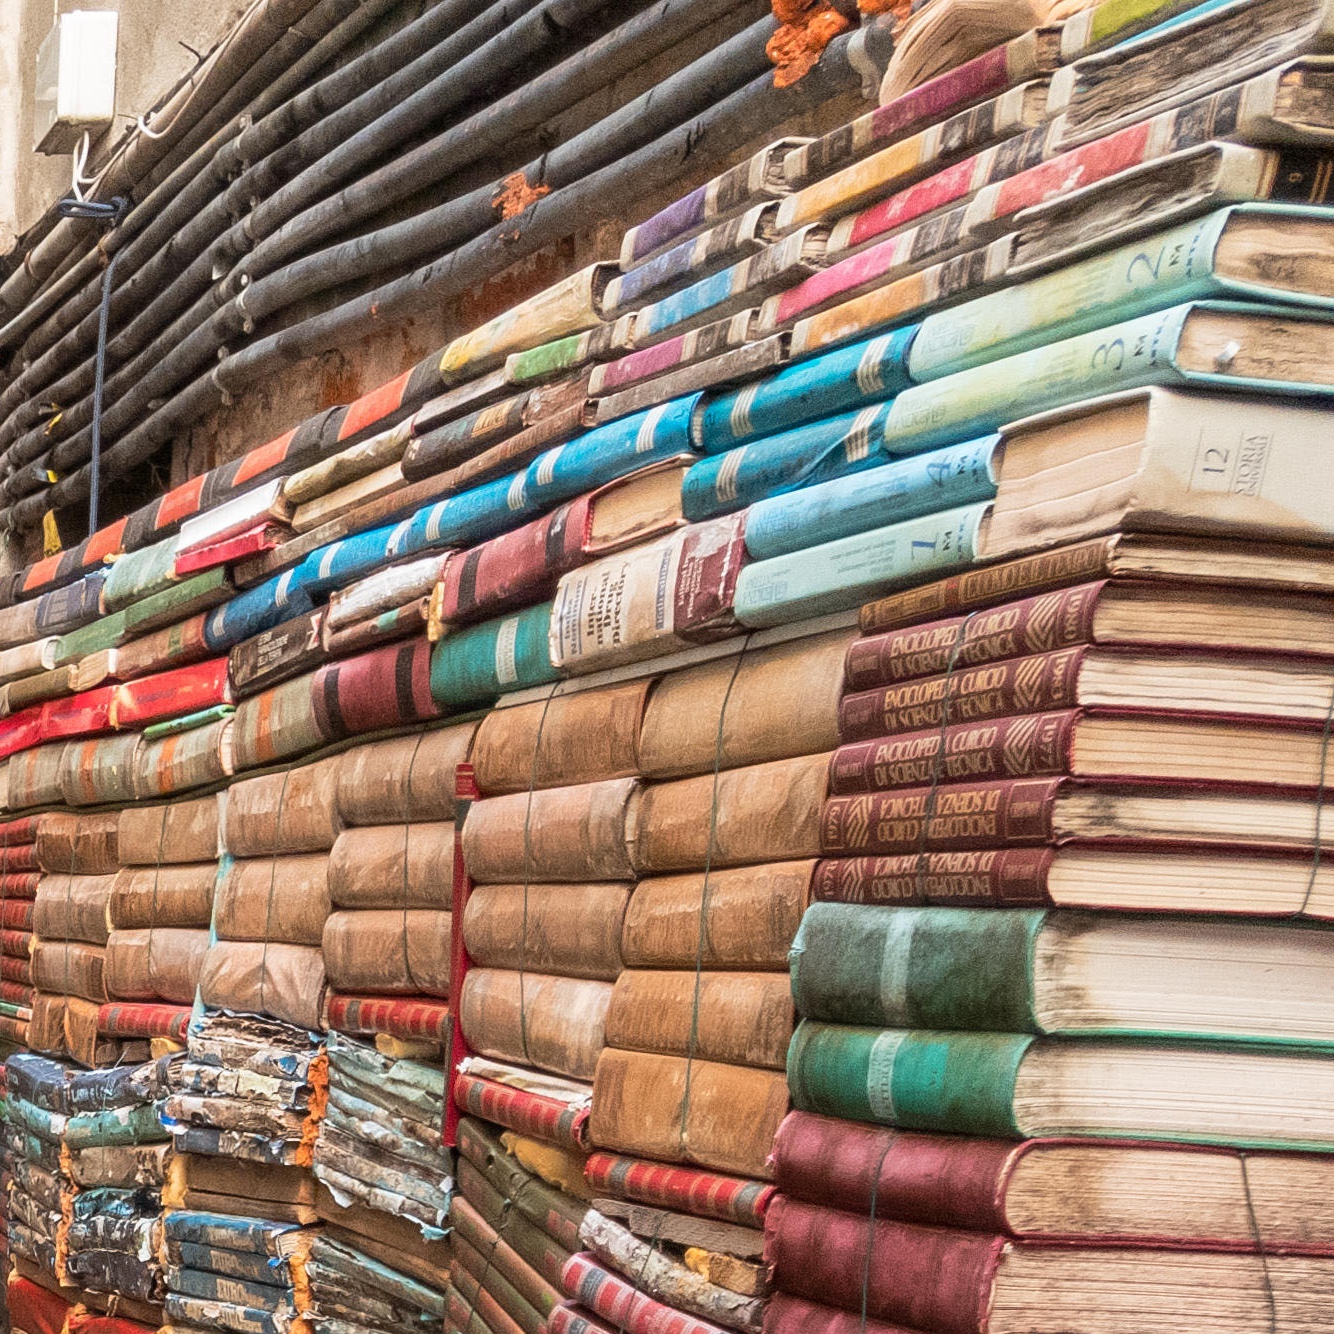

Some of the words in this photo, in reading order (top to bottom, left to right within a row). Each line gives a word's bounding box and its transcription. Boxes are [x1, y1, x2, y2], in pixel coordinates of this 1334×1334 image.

[1126, 245, 1167, 288] 2
[1090, 337, 1126, 372] 3
[1202, 446, 1229, 476] 12
[1234, 436, 1258, 495] STORIA
[603, 582, 619, 627] Drug
[611, 561, 630, 645] Directory
[888, 621, 972, 656] ENCICLOPEDA
[881, 677, 959, 711] ENCICLOPEDA
[871, 733, 952, 764] ENCICLOPEDA
[919, 814, 997, 839] ENCICLOPEDA
[916, 873, 991, 897] ENCICLOPEDA
